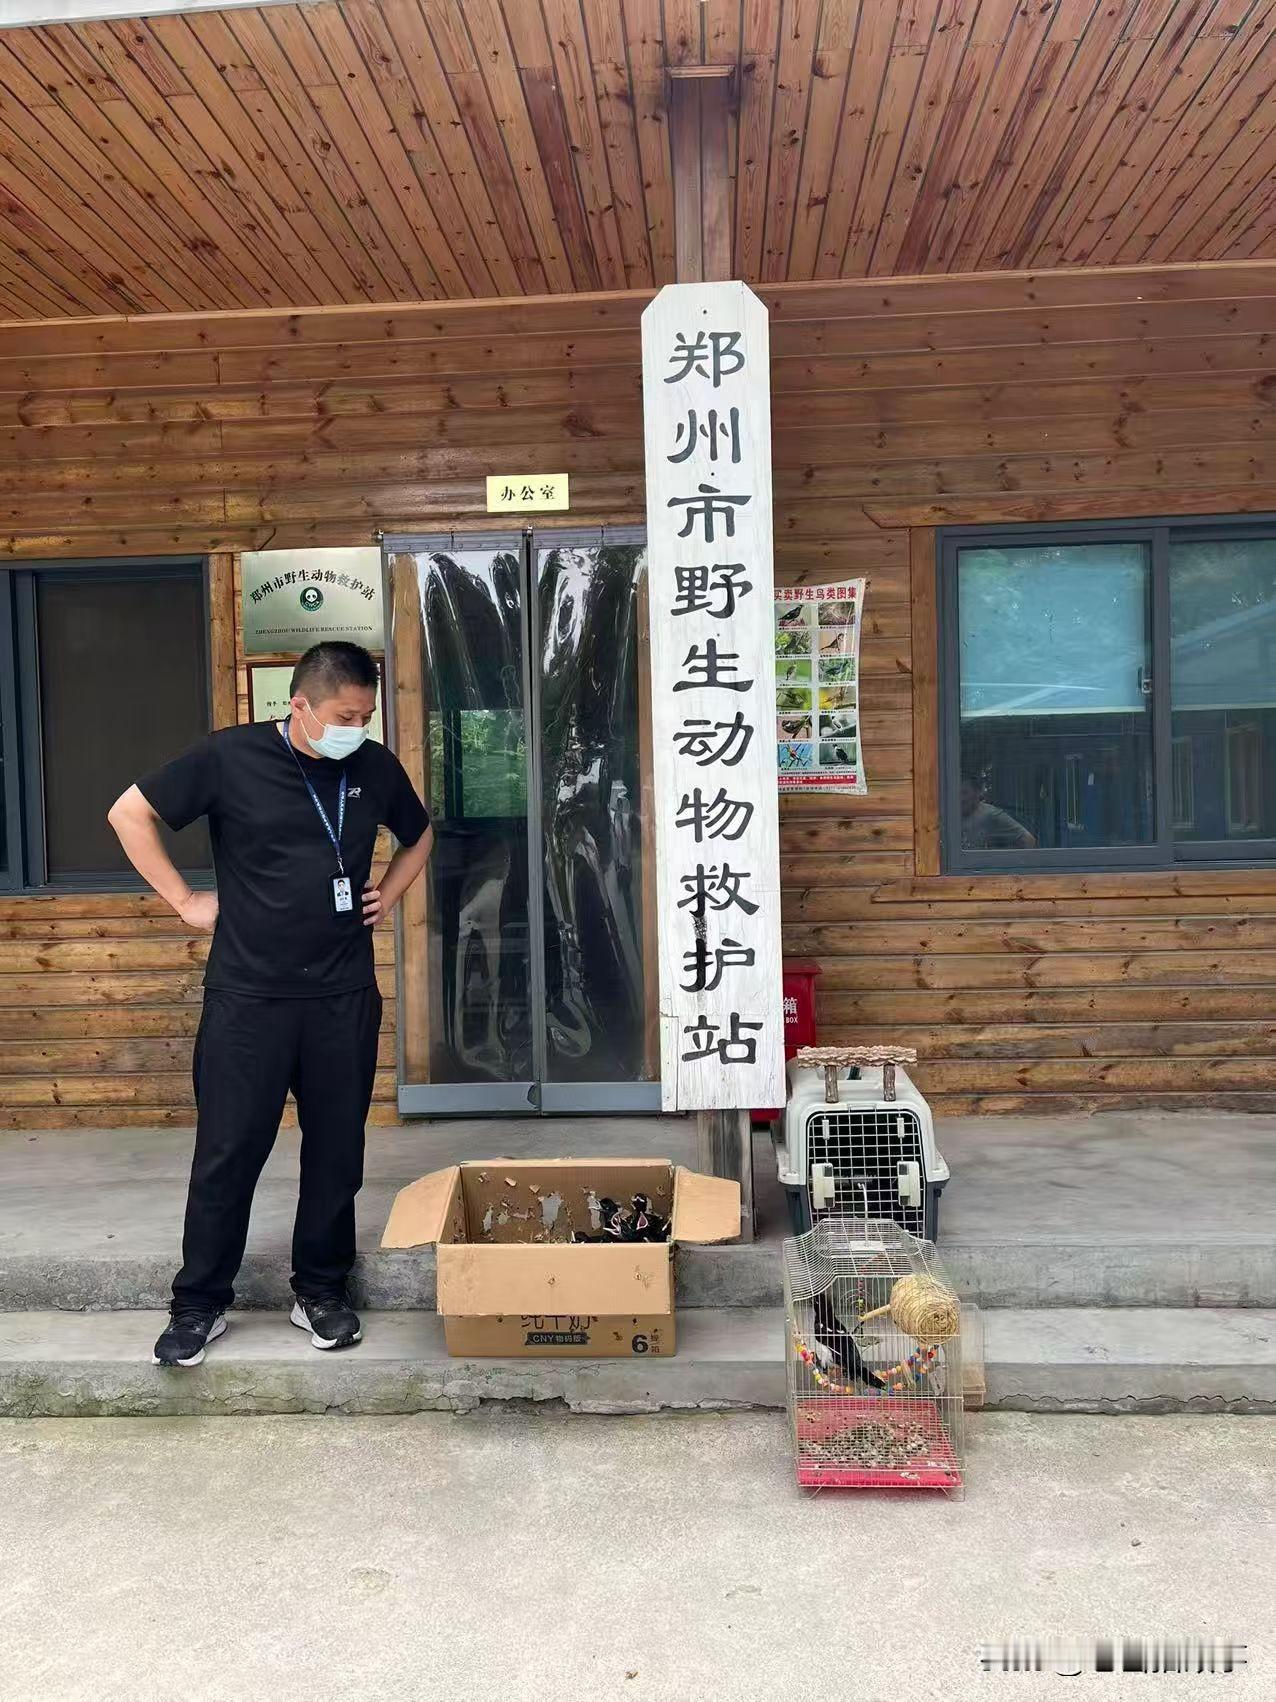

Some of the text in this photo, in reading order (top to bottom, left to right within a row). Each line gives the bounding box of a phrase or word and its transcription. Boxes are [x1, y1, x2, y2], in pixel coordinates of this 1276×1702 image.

[501, 485, 555, 501] 办公室
[250, 569, 376, 604] 郑州市野生动物救护站
[774, 587, 857, 601] 买卖野生鸟类图集
[664, 331, 763, 1066] 郑州市野生动物救护站
[783, 997, 797, 1014] 箱
[632, 1334, 649, 1353] 6
